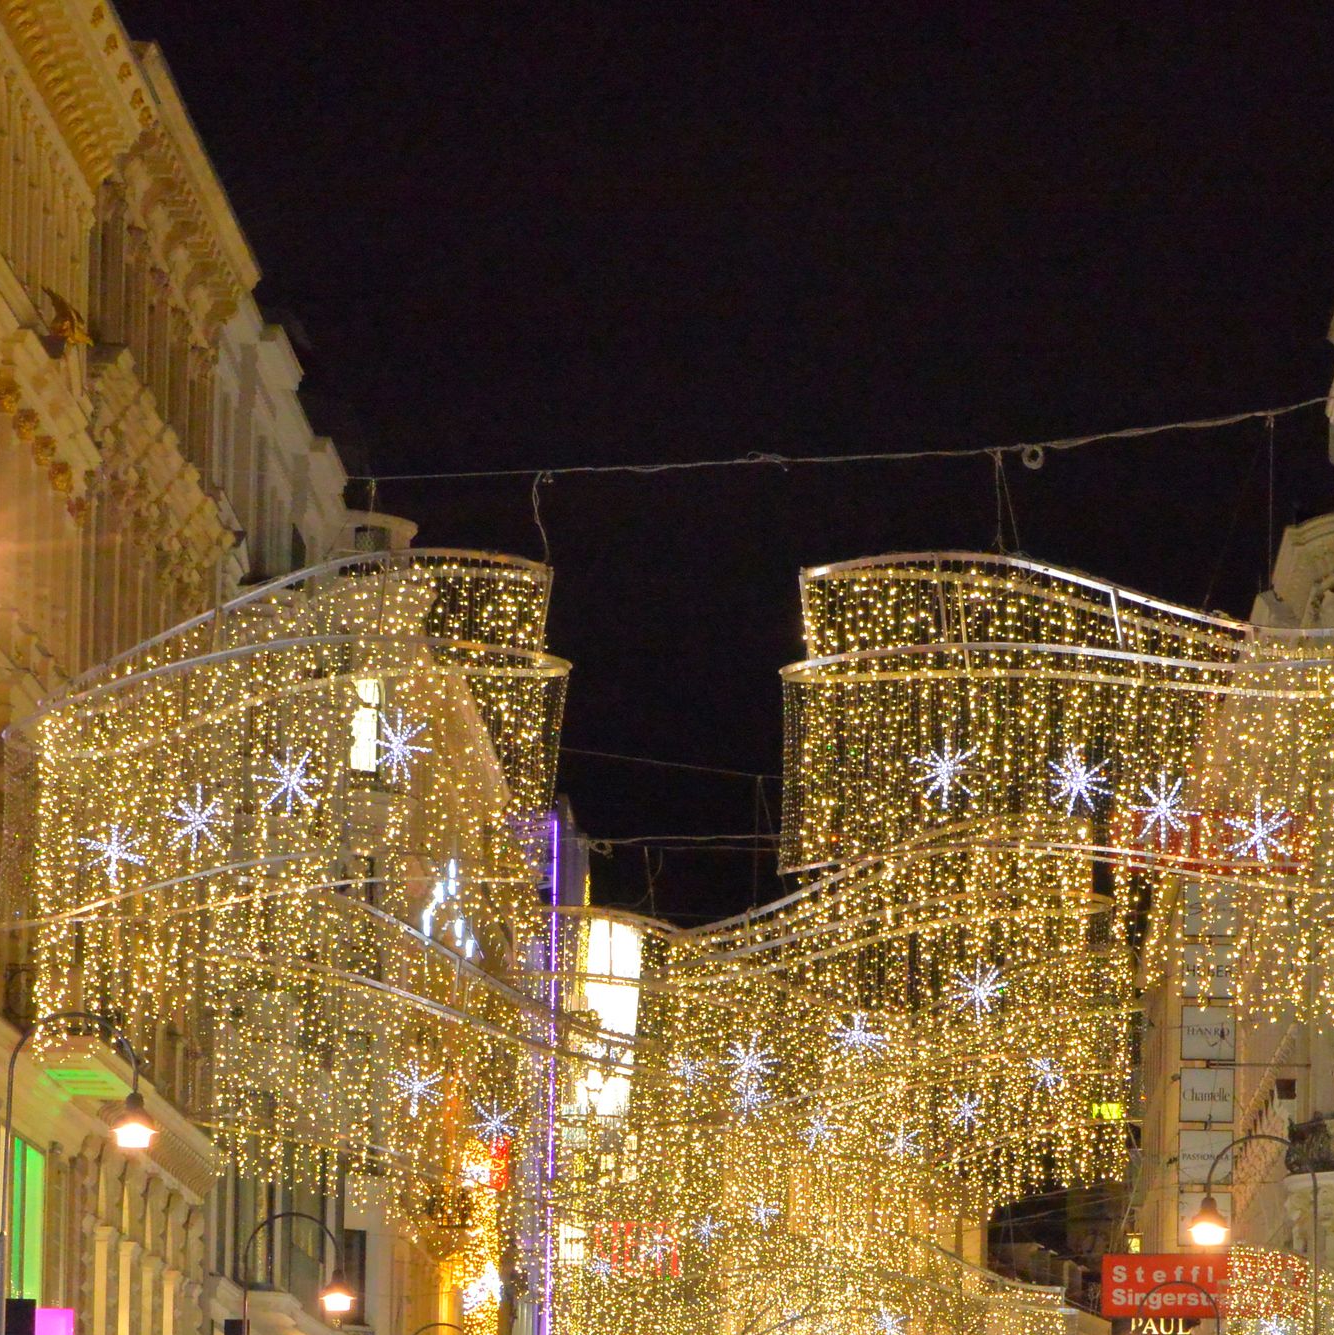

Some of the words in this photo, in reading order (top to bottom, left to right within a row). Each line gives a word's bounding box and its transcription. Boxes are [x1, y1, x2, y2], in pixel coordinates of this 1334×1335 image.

[1182, 1087, 1230, 1102] Chantelle
[1181, 1153, 1230, 1161] PASSIONTA
[1131, 1318, 1192, 1335] PAUL
